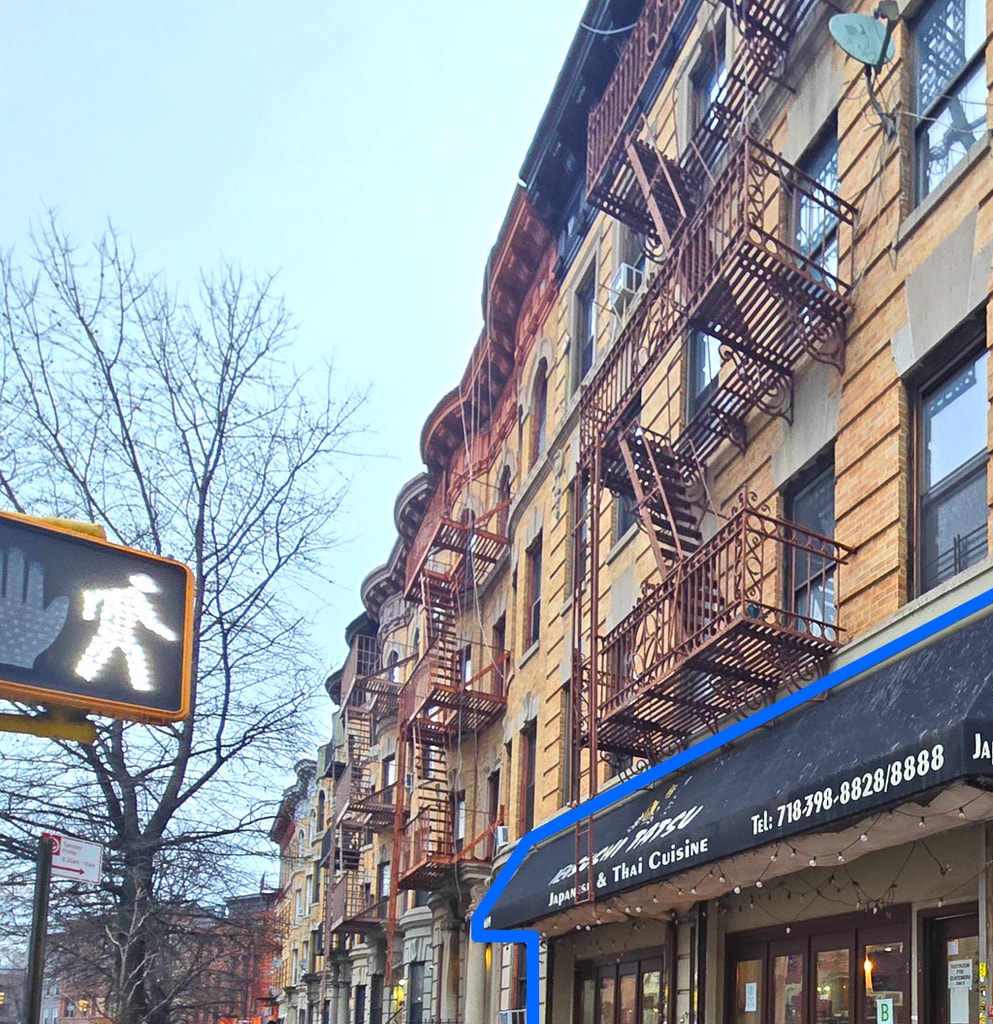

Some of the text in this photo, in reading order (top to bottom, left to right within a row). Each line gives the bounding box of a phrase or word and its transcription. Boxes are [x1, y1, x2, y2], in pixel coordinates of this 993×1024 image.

[751, 744, 945, 836] Tel: 718-398-8828/8888
[625, 805, 704, 853] TATSU
[548, 838, 709, 907] Japans & Thai Cuisine
[881, 1003, 889, 1021] B
